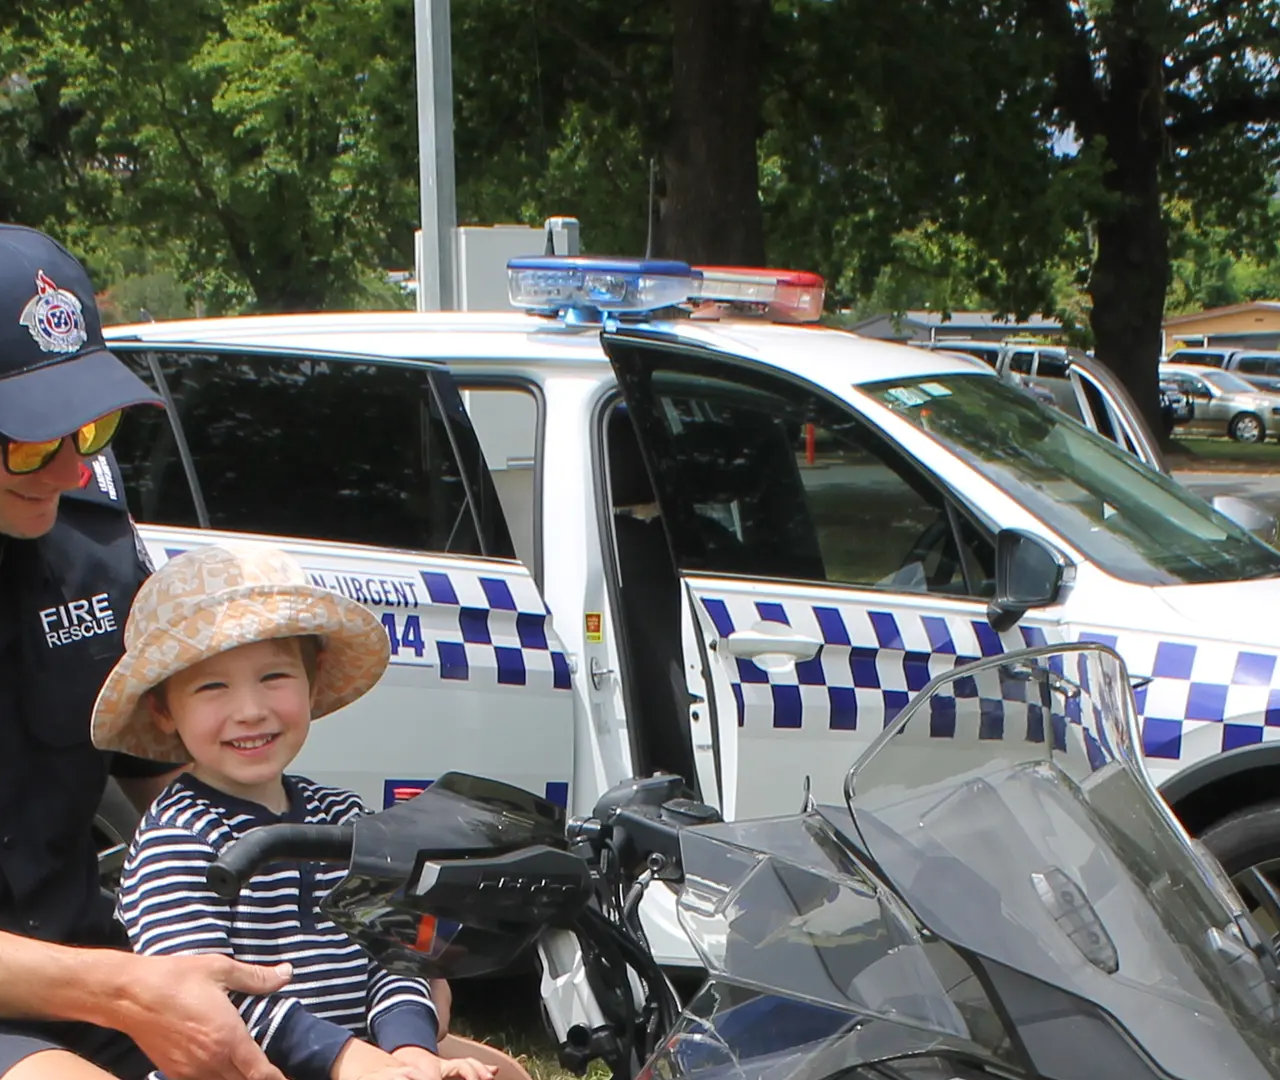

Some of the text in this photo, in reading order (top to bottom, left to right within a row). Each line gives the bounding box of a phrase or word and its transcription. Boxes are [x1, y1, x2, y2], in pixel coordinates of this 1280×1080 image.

[311, 572, 419, 609] N-URGENT
[39, 592, 113, 633] FIRE
[45, 615, 118, 649] RESCUE
[380, 612, 425, 658] 44
